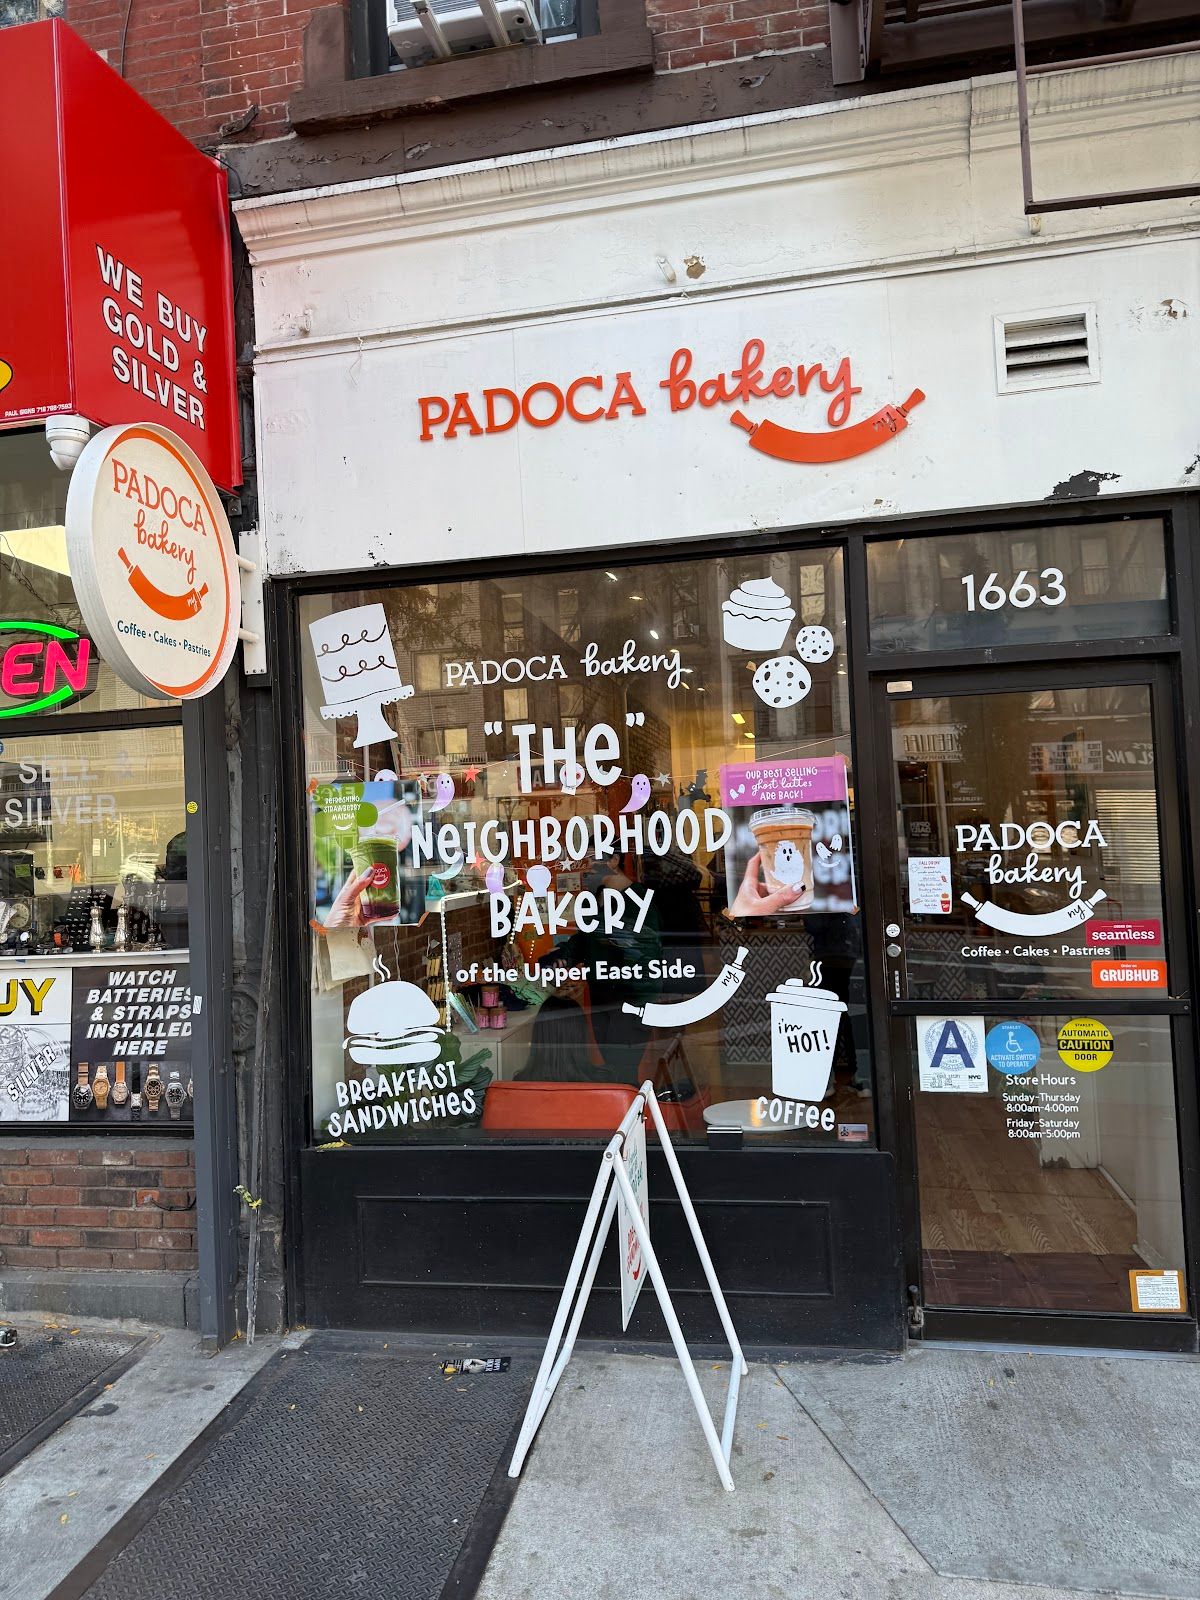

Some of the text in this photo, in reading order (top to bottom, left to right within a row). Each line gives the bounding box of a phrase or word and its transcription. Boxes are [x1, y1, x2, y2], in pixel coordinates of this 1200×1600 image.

[96, 244, 207, 352] WE BUY
[102, 296, 208, 394] GOLD &
[112, 345, 206, 431] SILVER
[418, 338, 863, 442] PADOCA bakery
[111, 458, 208, 537] PADOCA
[133, 508, 198, 585] bakery
[961, 567, 1067, 612] 1663
[117, 620, 211, 658] Coffee Cakes Pastries
[445, 639, 686, 689] PADOCA bakery
[19, 755, 98, 784] SELL
[745, 770, 761, 780] OUR
[751, 776, 812, 797] ghost lattes
[779, 790, 804, 800] BACK!
[4, 794, 118, 829] SILVER
[955, 819, 1108, 852] PADOCA
[984, 852, 1087, 899] bakery
[1091, 929, 1155, 941] seamless
[961, 945, 1111, 958] Coffee Cakes Pastries
[108, 970, 177, 986] WATCH
[455, 959, 697, 988] of the Upper East Side
[1100, 968, 1160, 982] GRUBHUB
[91, 1006, 104, 1021] &
[113, 1004, 192, 1021] STRAPS
[86, 1022, 192, 1039] INSTALLED
[1061, 1029, 1109, 1038] AUTOMATIC
[112, 1040, 169, 1056] HERE
[787, 1029, 831, 1054] HOT!
[930, 1020, 976, 1069] A
[1059, 1039, 1111, 1051] CAUTION
[990, 1053, 1037, 1061] ACTIVATE SWITCH
[1074, 1053, 1098, 1061] DOOR
[7, 1045, 57, 1102] SILVER
[1006, 1073, 1077, 1086] Store Hours
[1002, 1092, 1081, 1104] Sunday-Thursday
[1006, 1103, 1079, 1114] 8:00am-4:00pm
[1006, 1118, 1080, 1130] Friday-Saturday
[1008, 1129, 1081, 1139] 8:00am-5:00pm
